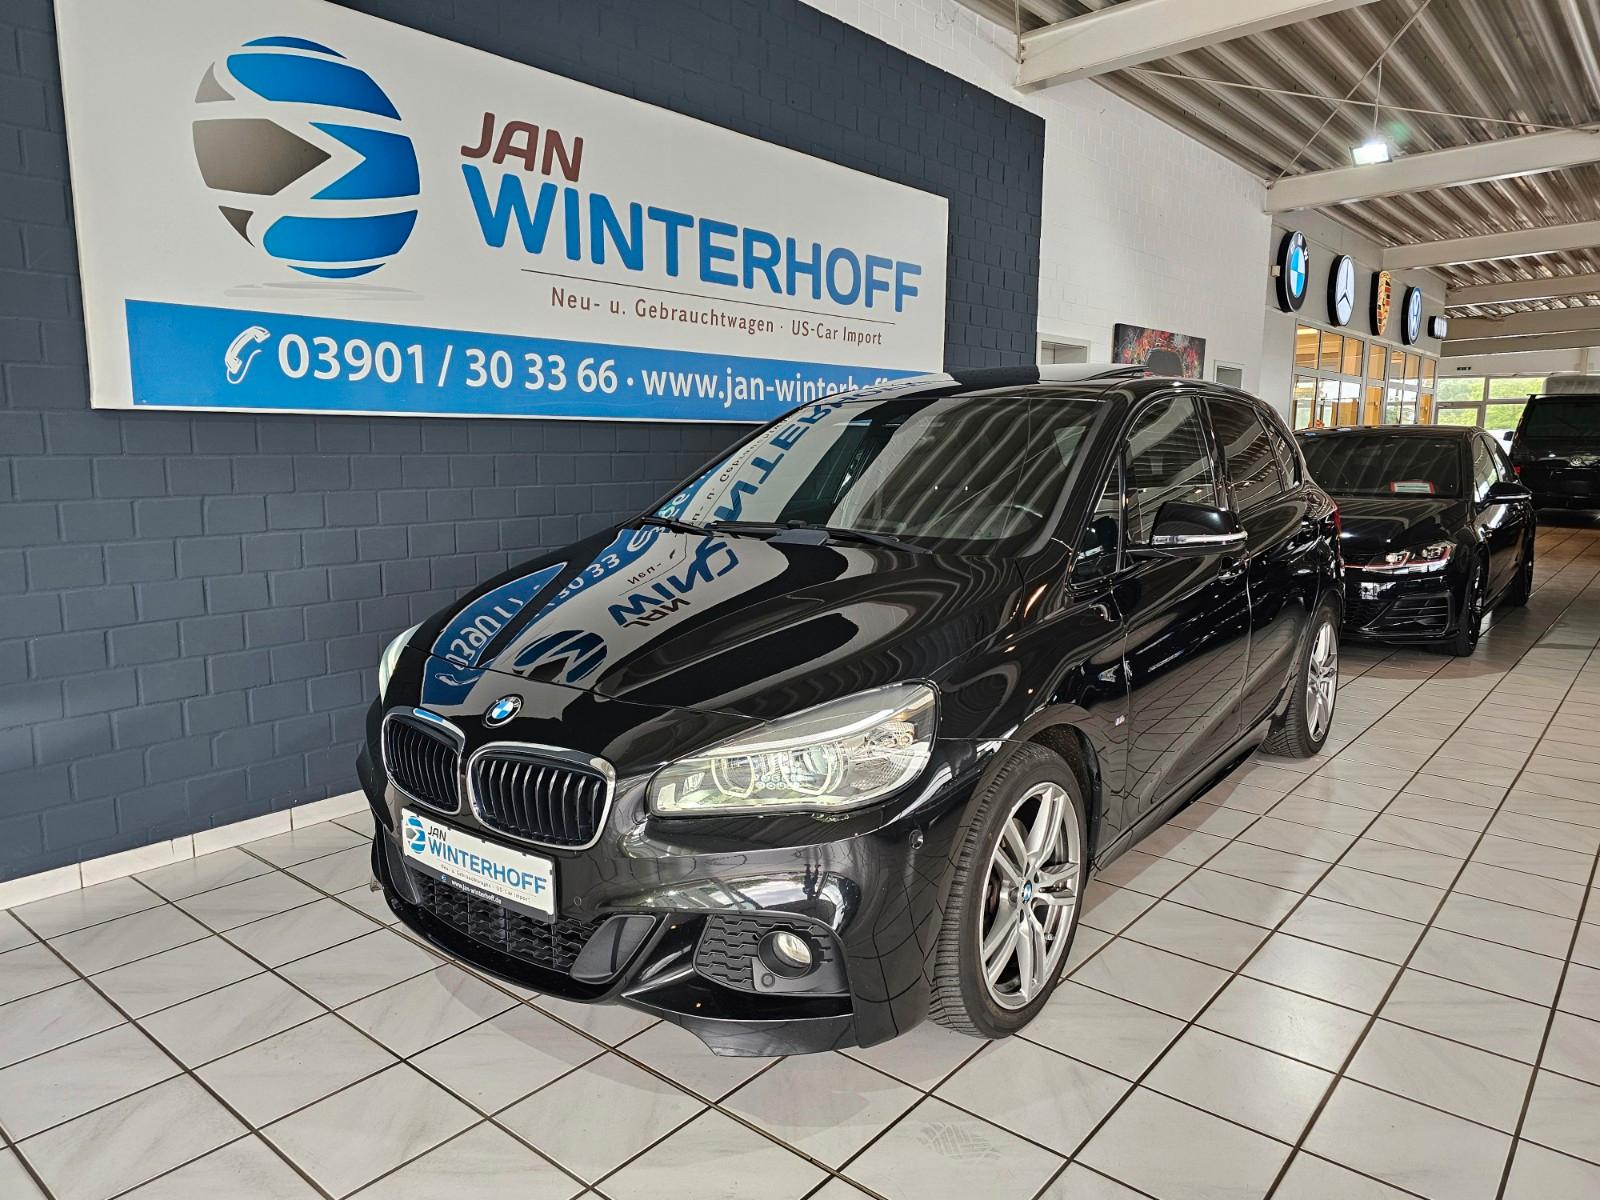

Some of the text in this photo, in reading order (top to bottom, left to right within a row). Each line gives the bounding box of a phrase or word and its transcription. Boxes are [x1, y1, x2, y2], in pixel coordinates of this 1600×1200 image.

[461, 112, 583, 182] JAN
[461, 163, 921, 312] WINTERHOFF
[552, 287, 882, 346] Neu- u. Gebrauchtwagen US-Car Import
[278, 333, 424, 384] 03901
[465, 349, 513, 388] 30
[524, 353, 567, 391] 33
[577, 358, 618, 394] 66
[428, 825, 447, 841] JAN
[428, 839, 546, 894] WINTERHOFF
